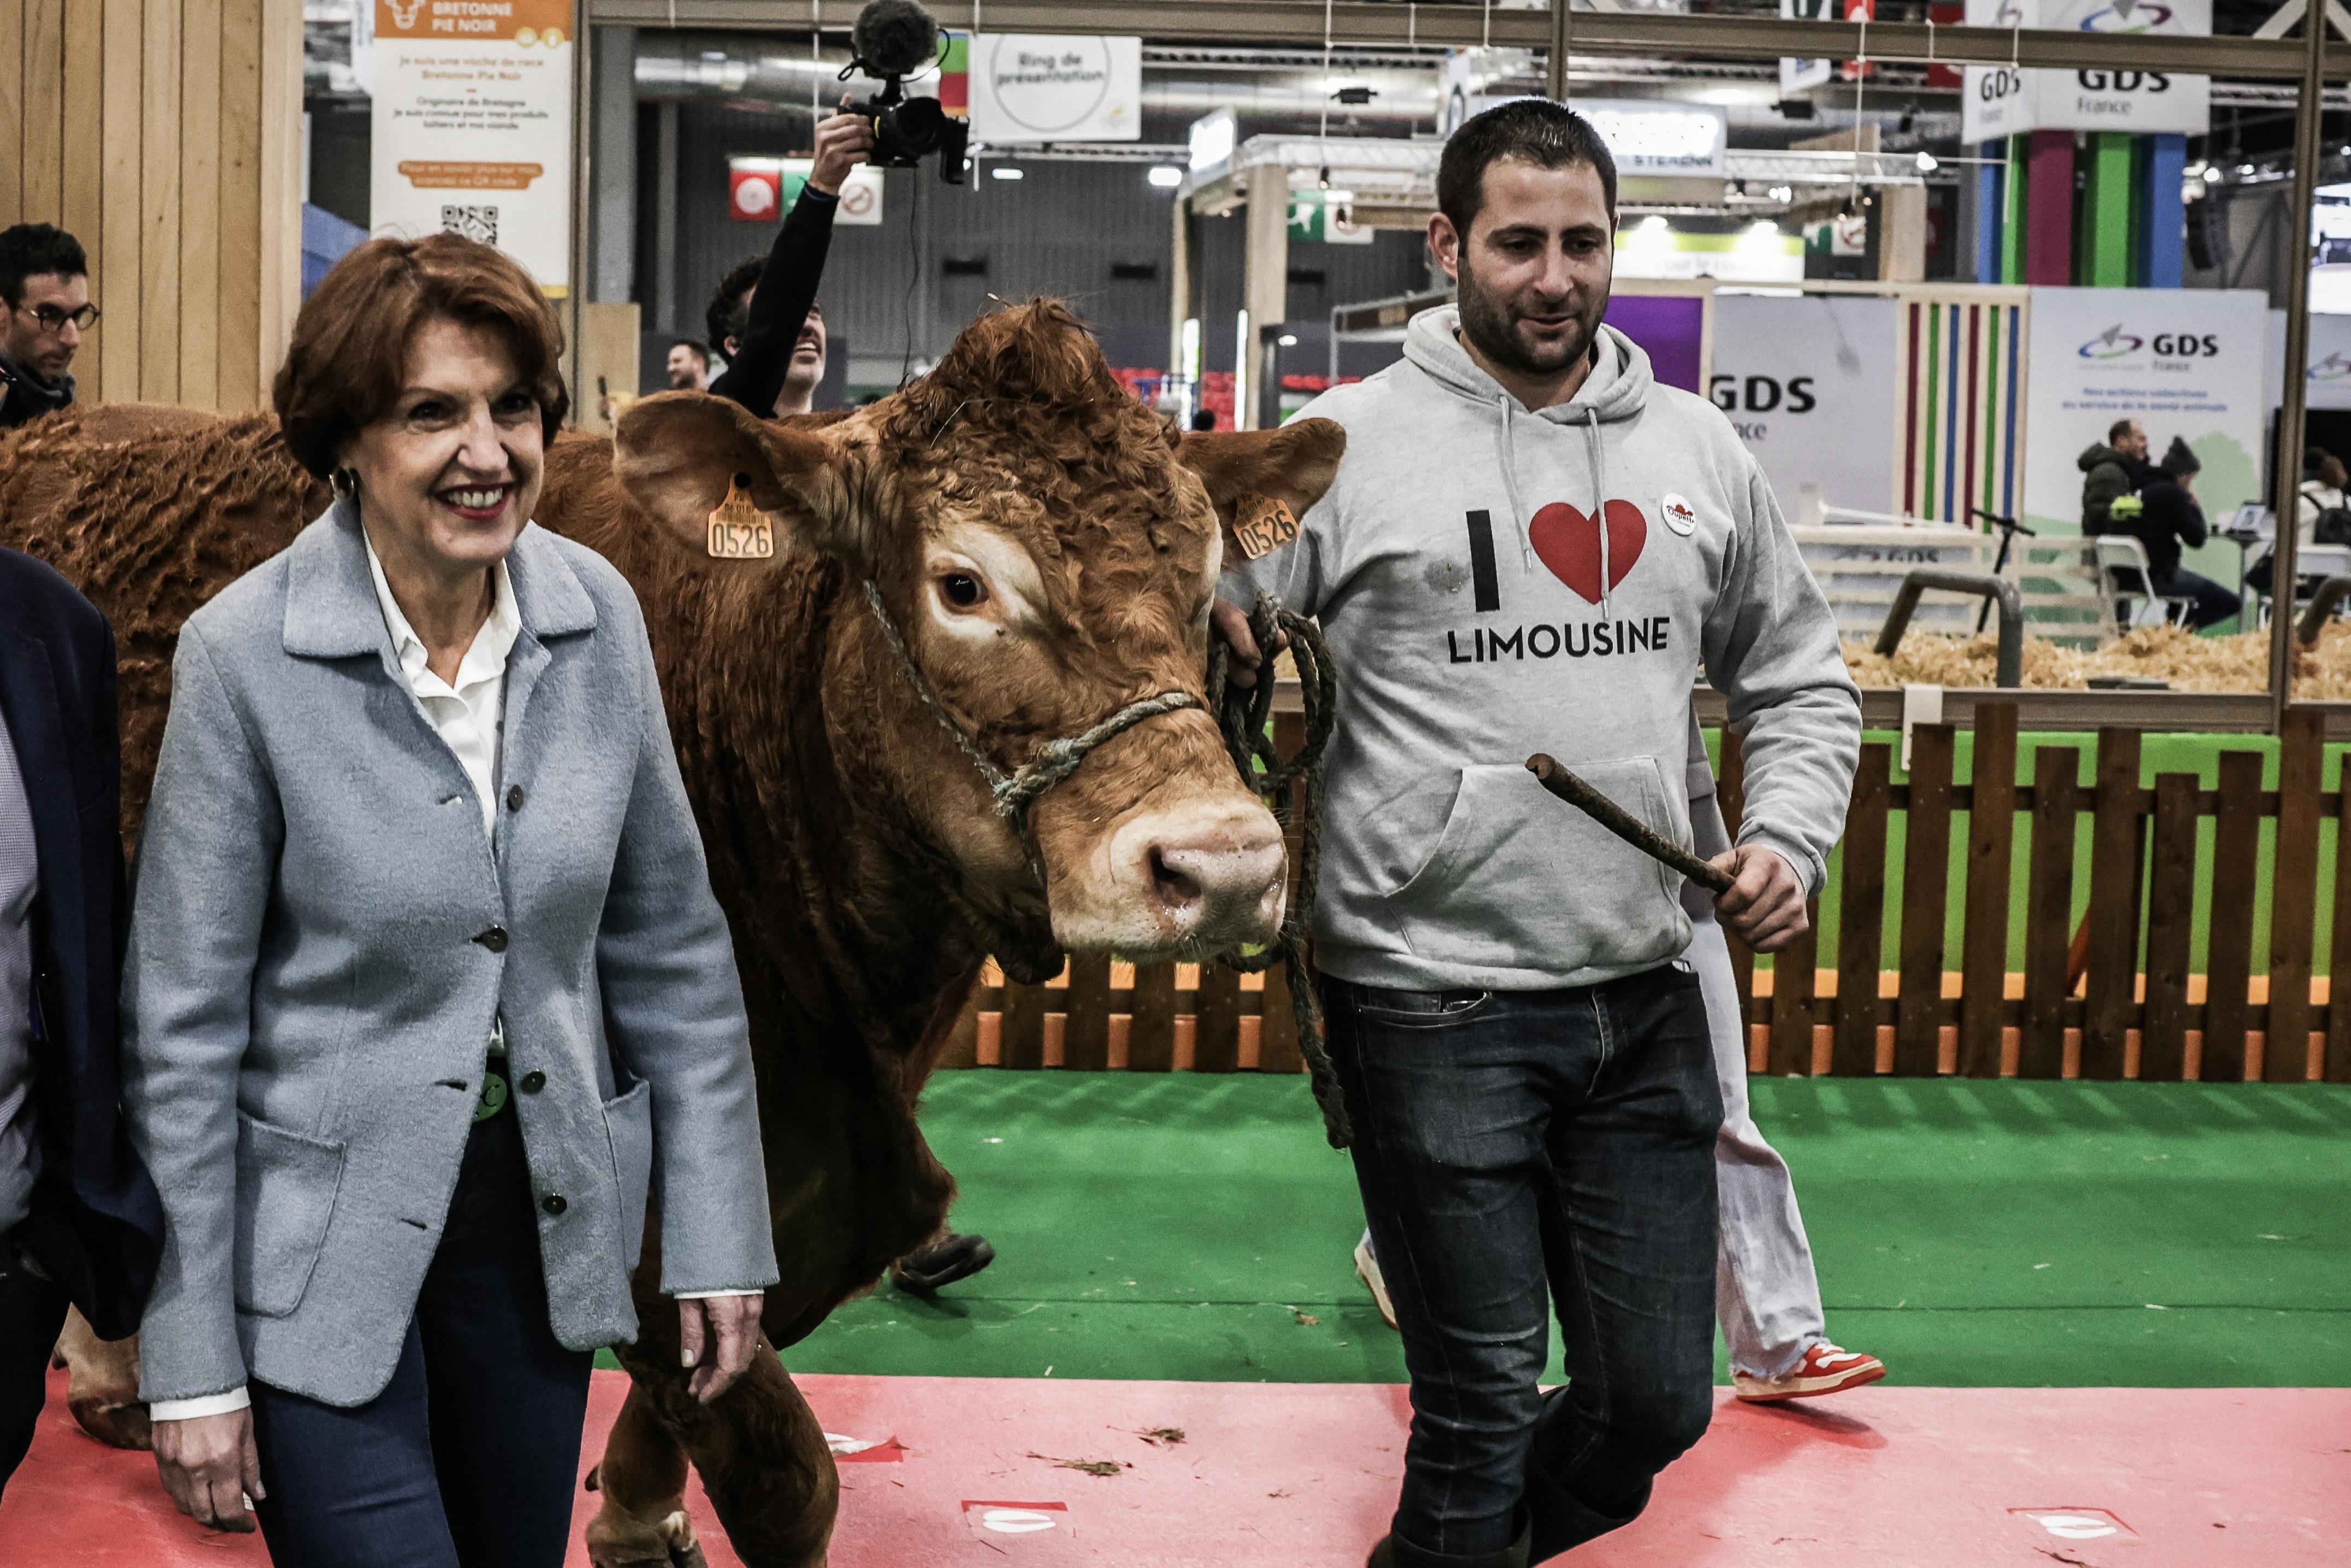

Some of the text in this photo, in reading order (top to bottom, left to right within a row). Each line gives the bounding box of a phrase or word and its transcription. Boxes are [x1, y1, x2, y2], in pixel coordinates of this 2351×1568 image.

[432, 2, 513, 16] BRETONNE
[432, 18, 497, 33] PIE NOIR
[501, 57, 514, 66] de
[1060, 51, 1082, 66] de
[422, 70, 521, 80] Bretonne Pie Noir
[2078, 69, 2170, 92] GDS
[483, 98, 525, 108] Bretagne
[2078, 96, 2132, 116] France
[2153, 333, 2220, 358] GDS
[1709, 375, 1816, 414] GDS
[713, 523, 769, 554] 0526
[1240, 510, 1297, 555] 0526
[1466, 509, 1500, 613] I
[1447, 616, 1670, 664] LIMOUSINE
